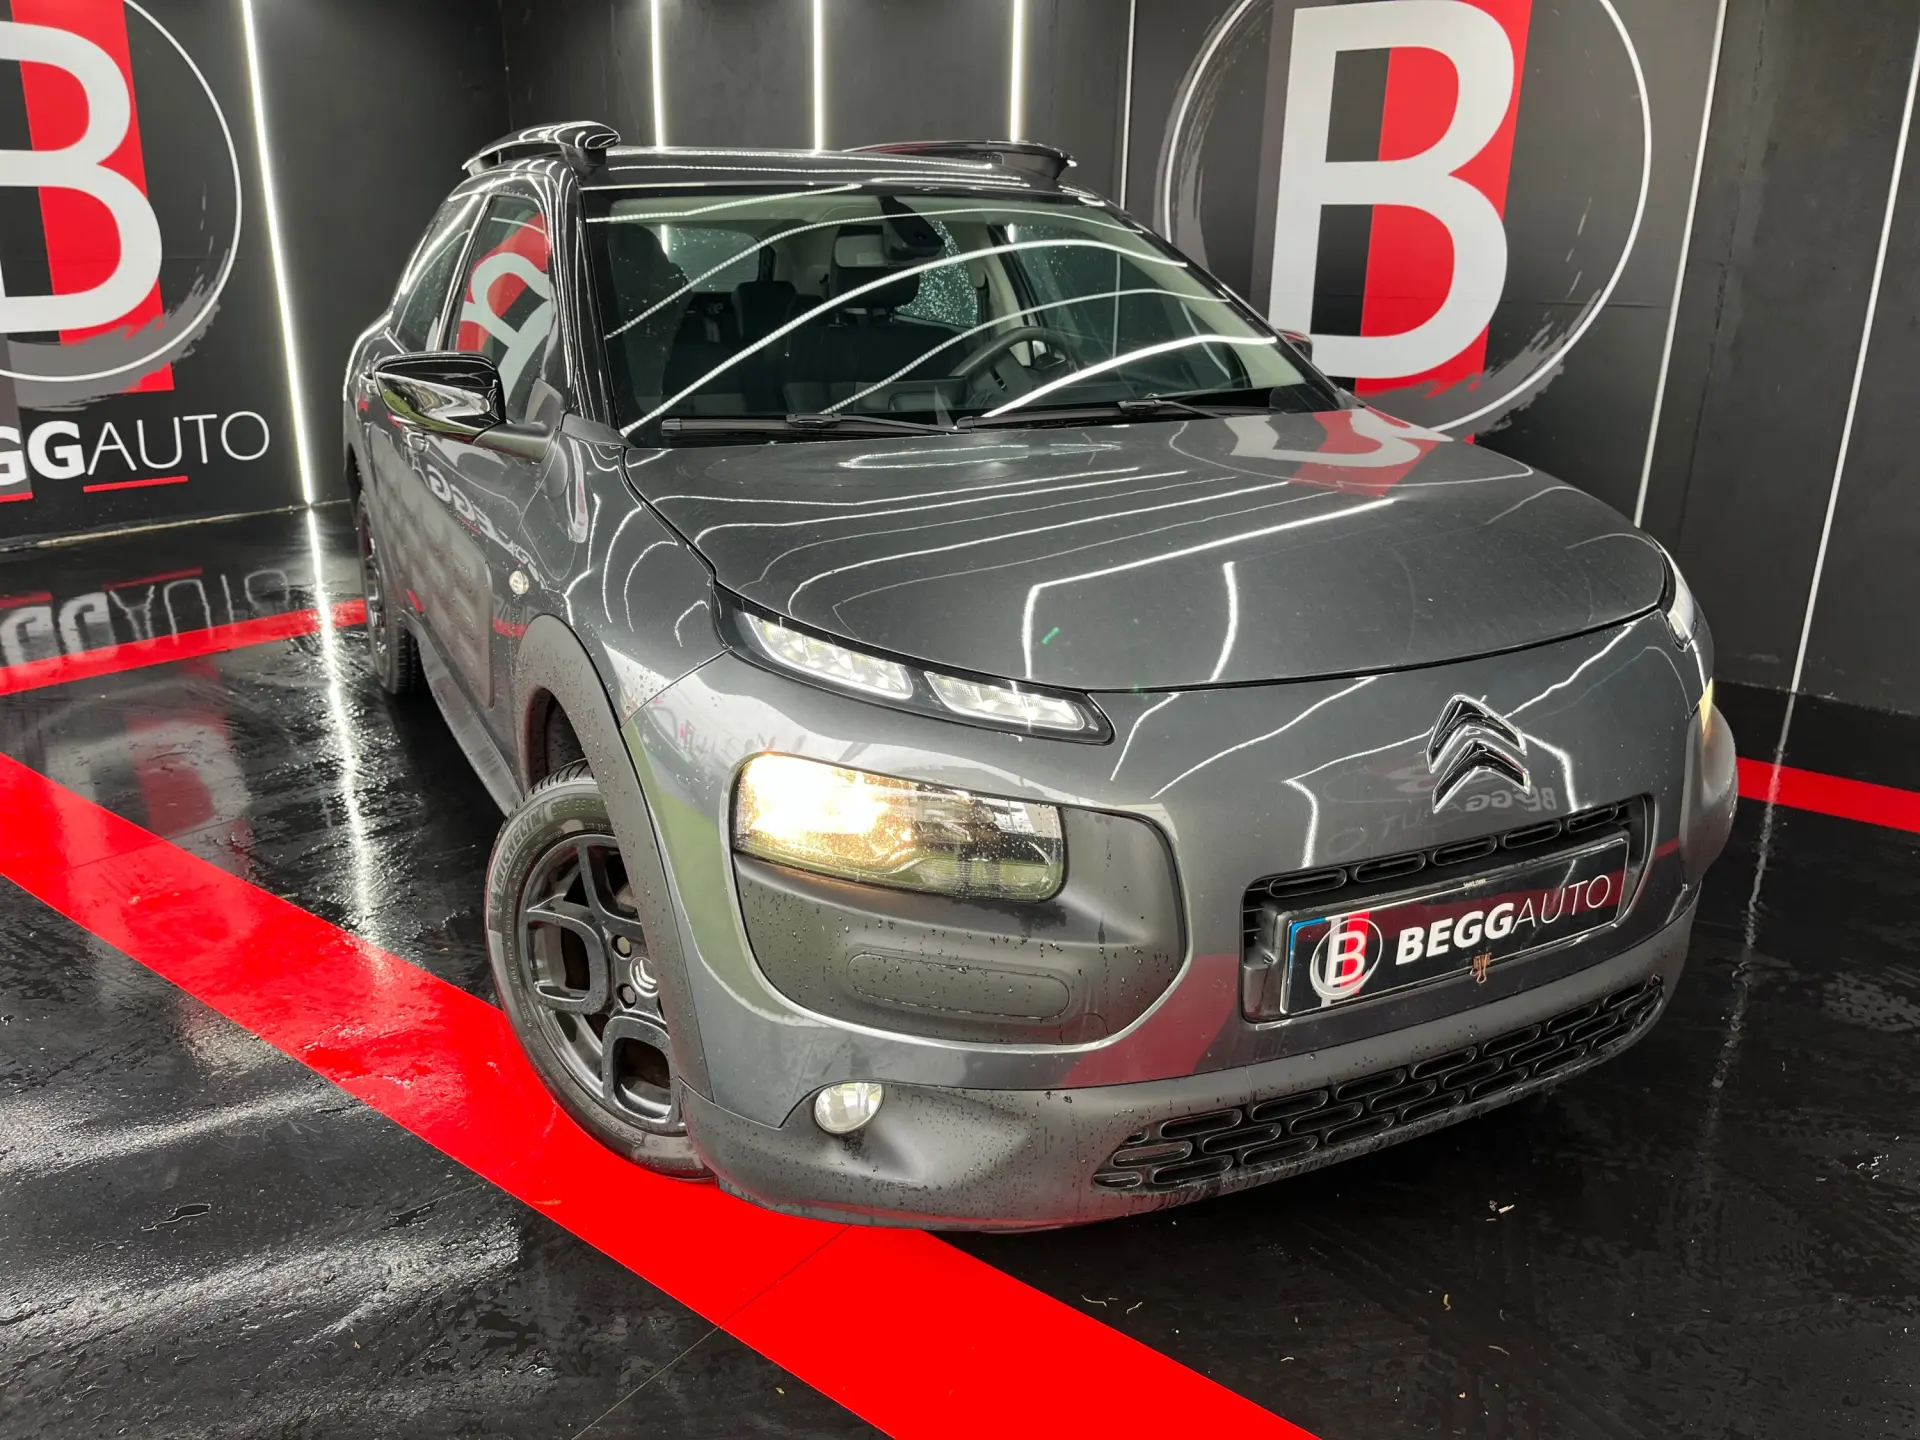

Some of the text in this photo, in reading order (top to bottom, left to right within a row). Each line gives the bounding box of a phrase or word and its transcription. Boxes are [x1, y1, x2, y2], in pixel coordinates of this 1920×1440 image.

[1268, 0, 1514, 379] B
[494, 808, 543, 889] MICHELIN
[1326, 930, 1367, 988] B
[1396, 875, 1611, 966] BEGGAUTO
